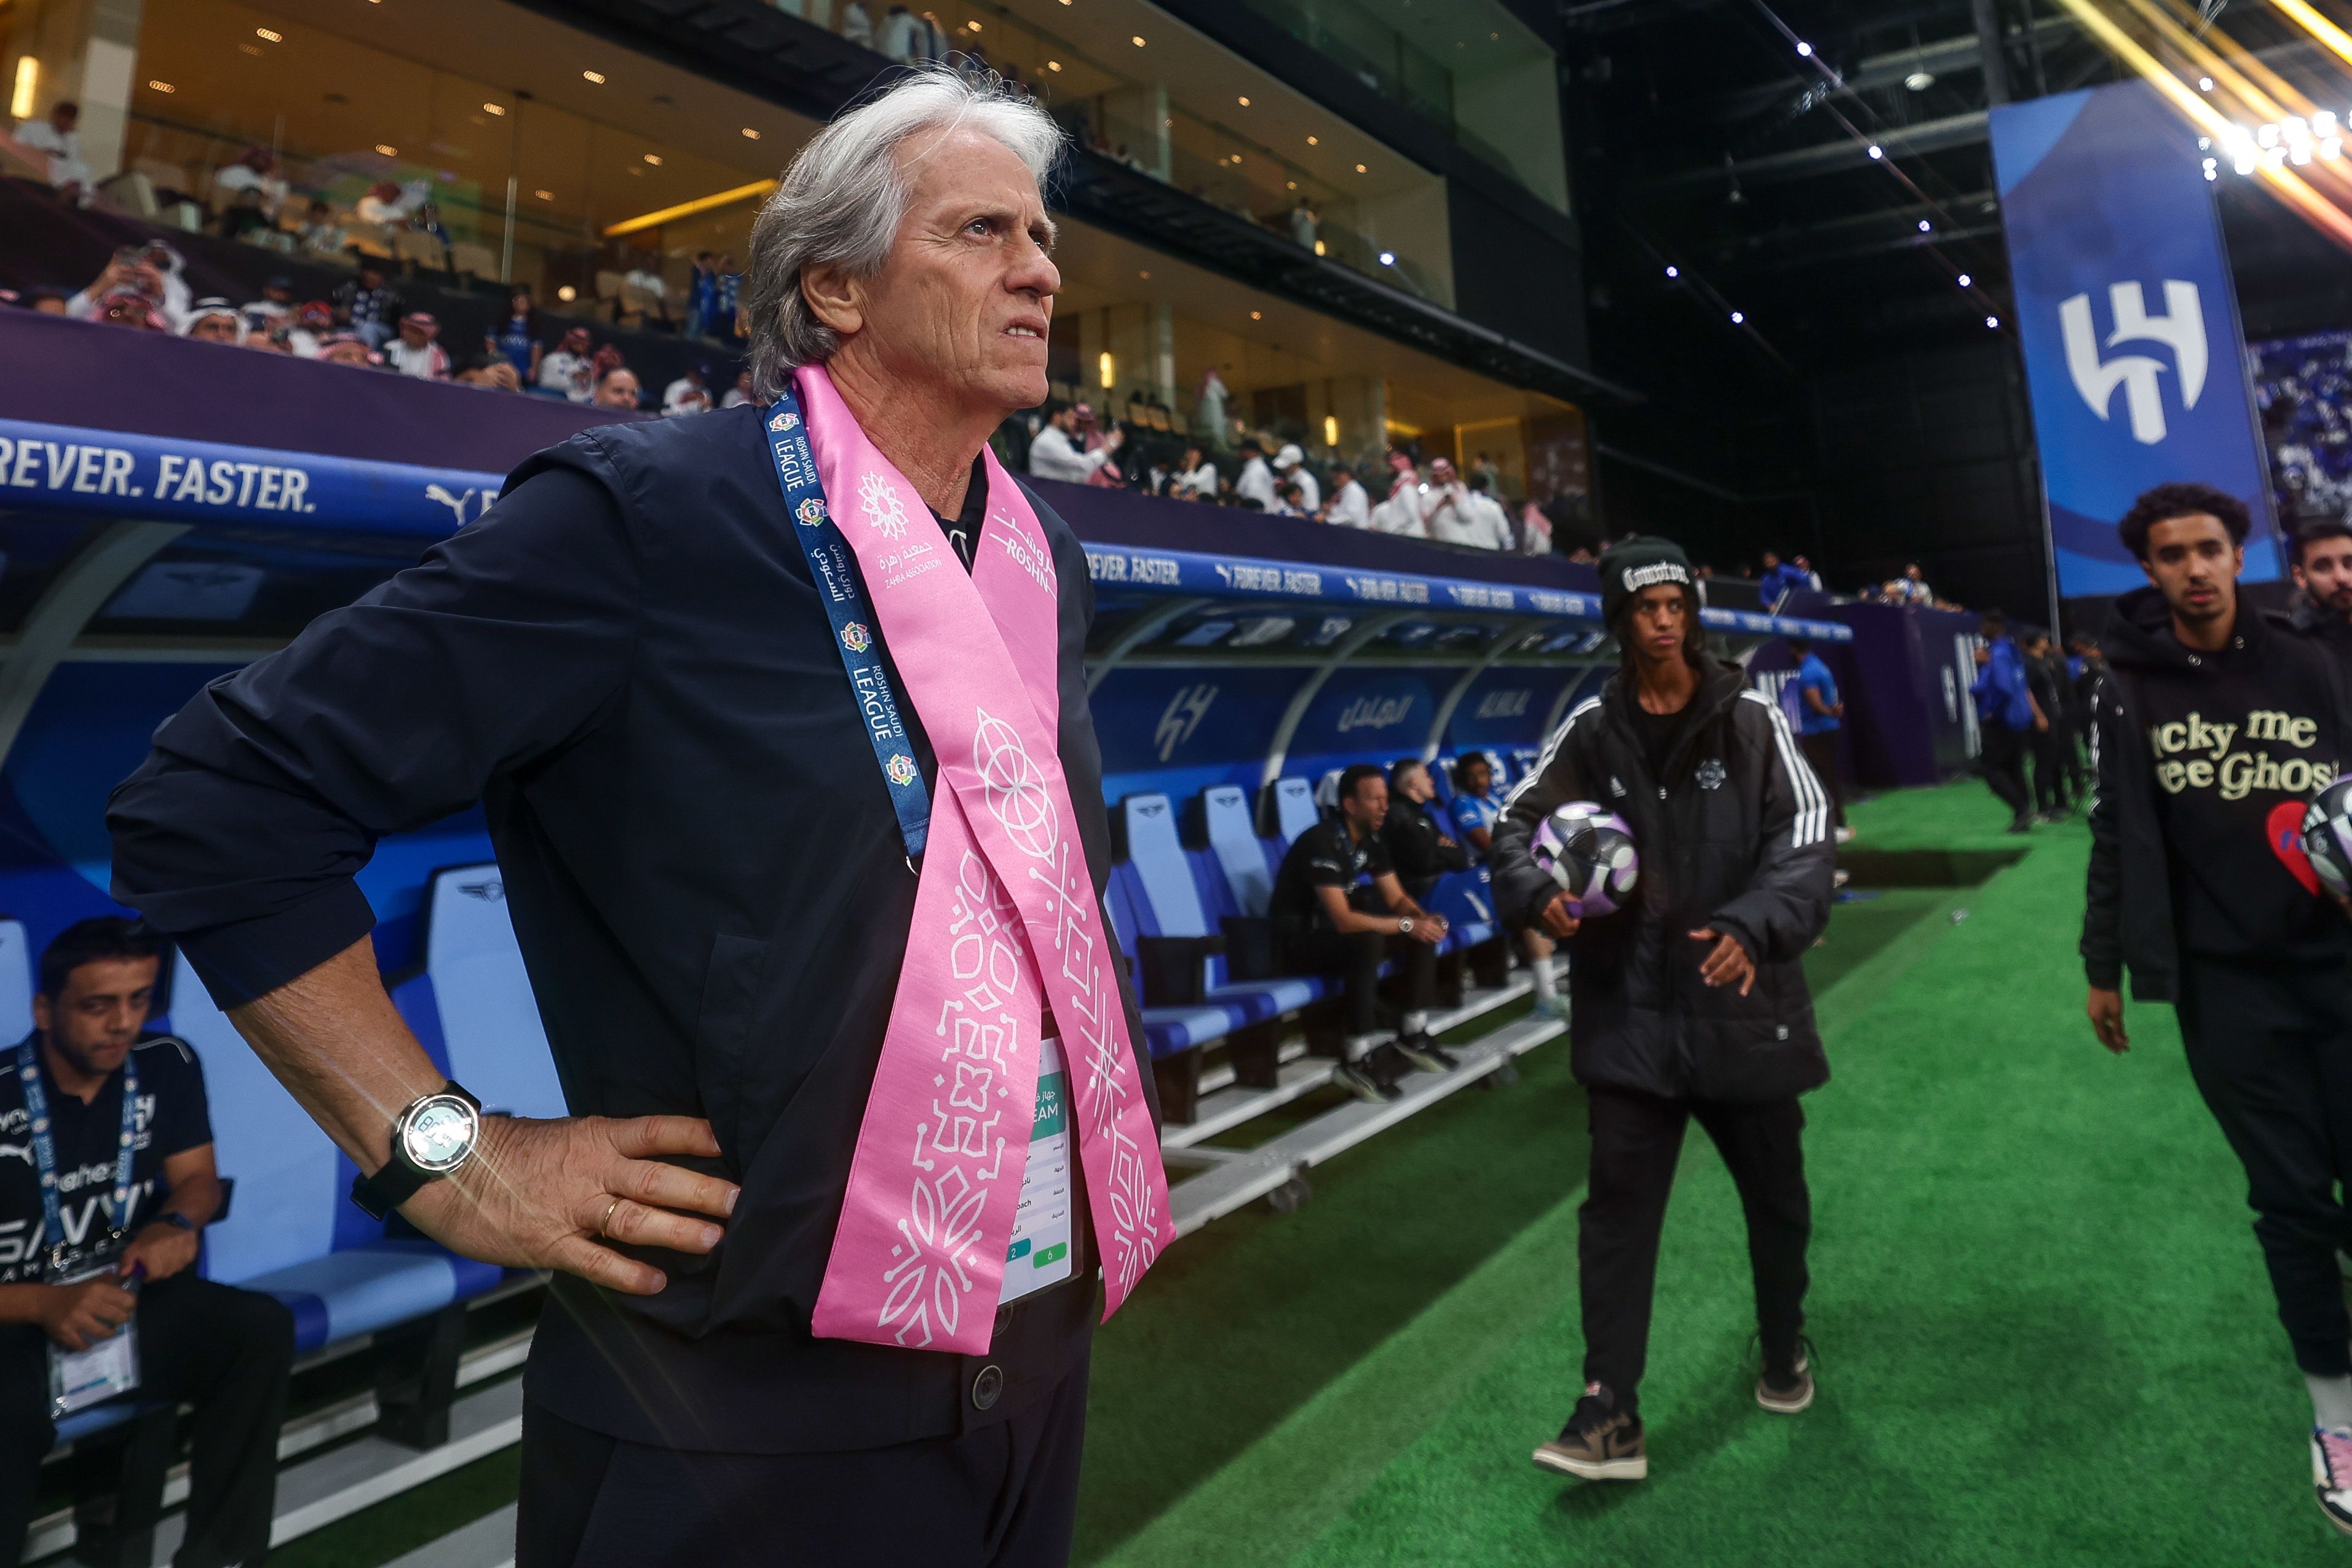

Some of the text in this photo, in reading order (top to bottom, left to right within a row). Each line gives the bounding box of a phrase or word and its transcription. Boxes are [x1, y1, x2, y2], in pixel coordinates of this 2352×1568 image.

[153, 454, 316, 513] FASTER.
[775, 438, 804, 493] LEAGUE
[795, 436, 817, 485] ROSHN SAUDI
[810, 548, 845, 602] السعودي
[830, 544, 855, 599] دوري روشن
[877, 542, 933, 574] جمعية زهرة
[885, 558, 942, 589] ZAHRA ASSOCIATION
[853, 667, 892, 742] LEAGUE
[872, 665, 904, 738] ROSHN SAUDI
[2246, 710, 2318, 748] me
[2218, 750, 2340, 801] Ghos
[1033, 1103, 1059, 1123] EAM
[1016, 1199, 1032, 1210] oach
[1011, 1248, 1016, 1259] 2
[1047, 1250, 1053, 1261] 6
